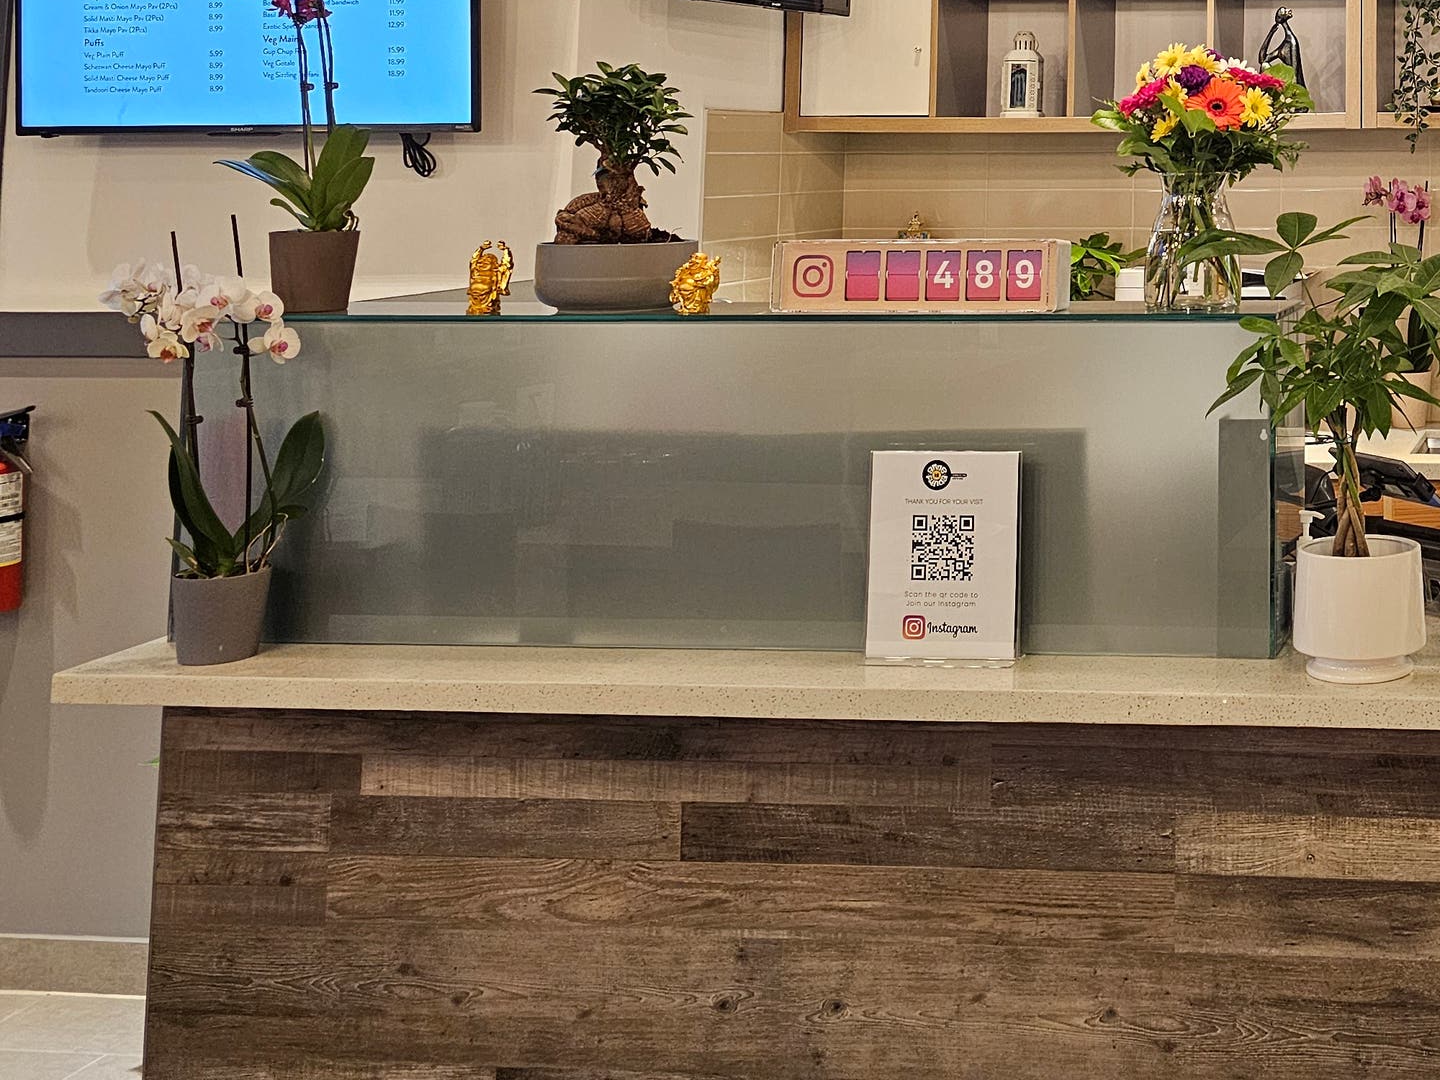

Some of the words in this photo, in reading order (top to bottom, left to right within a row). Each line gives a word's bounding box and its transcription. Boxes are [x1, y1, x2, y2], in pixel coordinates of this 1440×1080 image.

[130, 3, 147, 11] Mayo
[100, 27, 116, 35] Mayo
[84, 38, 104, 47] Puffs
[263, 35, 278, 46] Veg
[139, 75, 155, 83] Mayo
[132, 86, 148, 95] Mayo
[949, 591, 968, 599] code
[927, 622, 978, 638] Instagram
